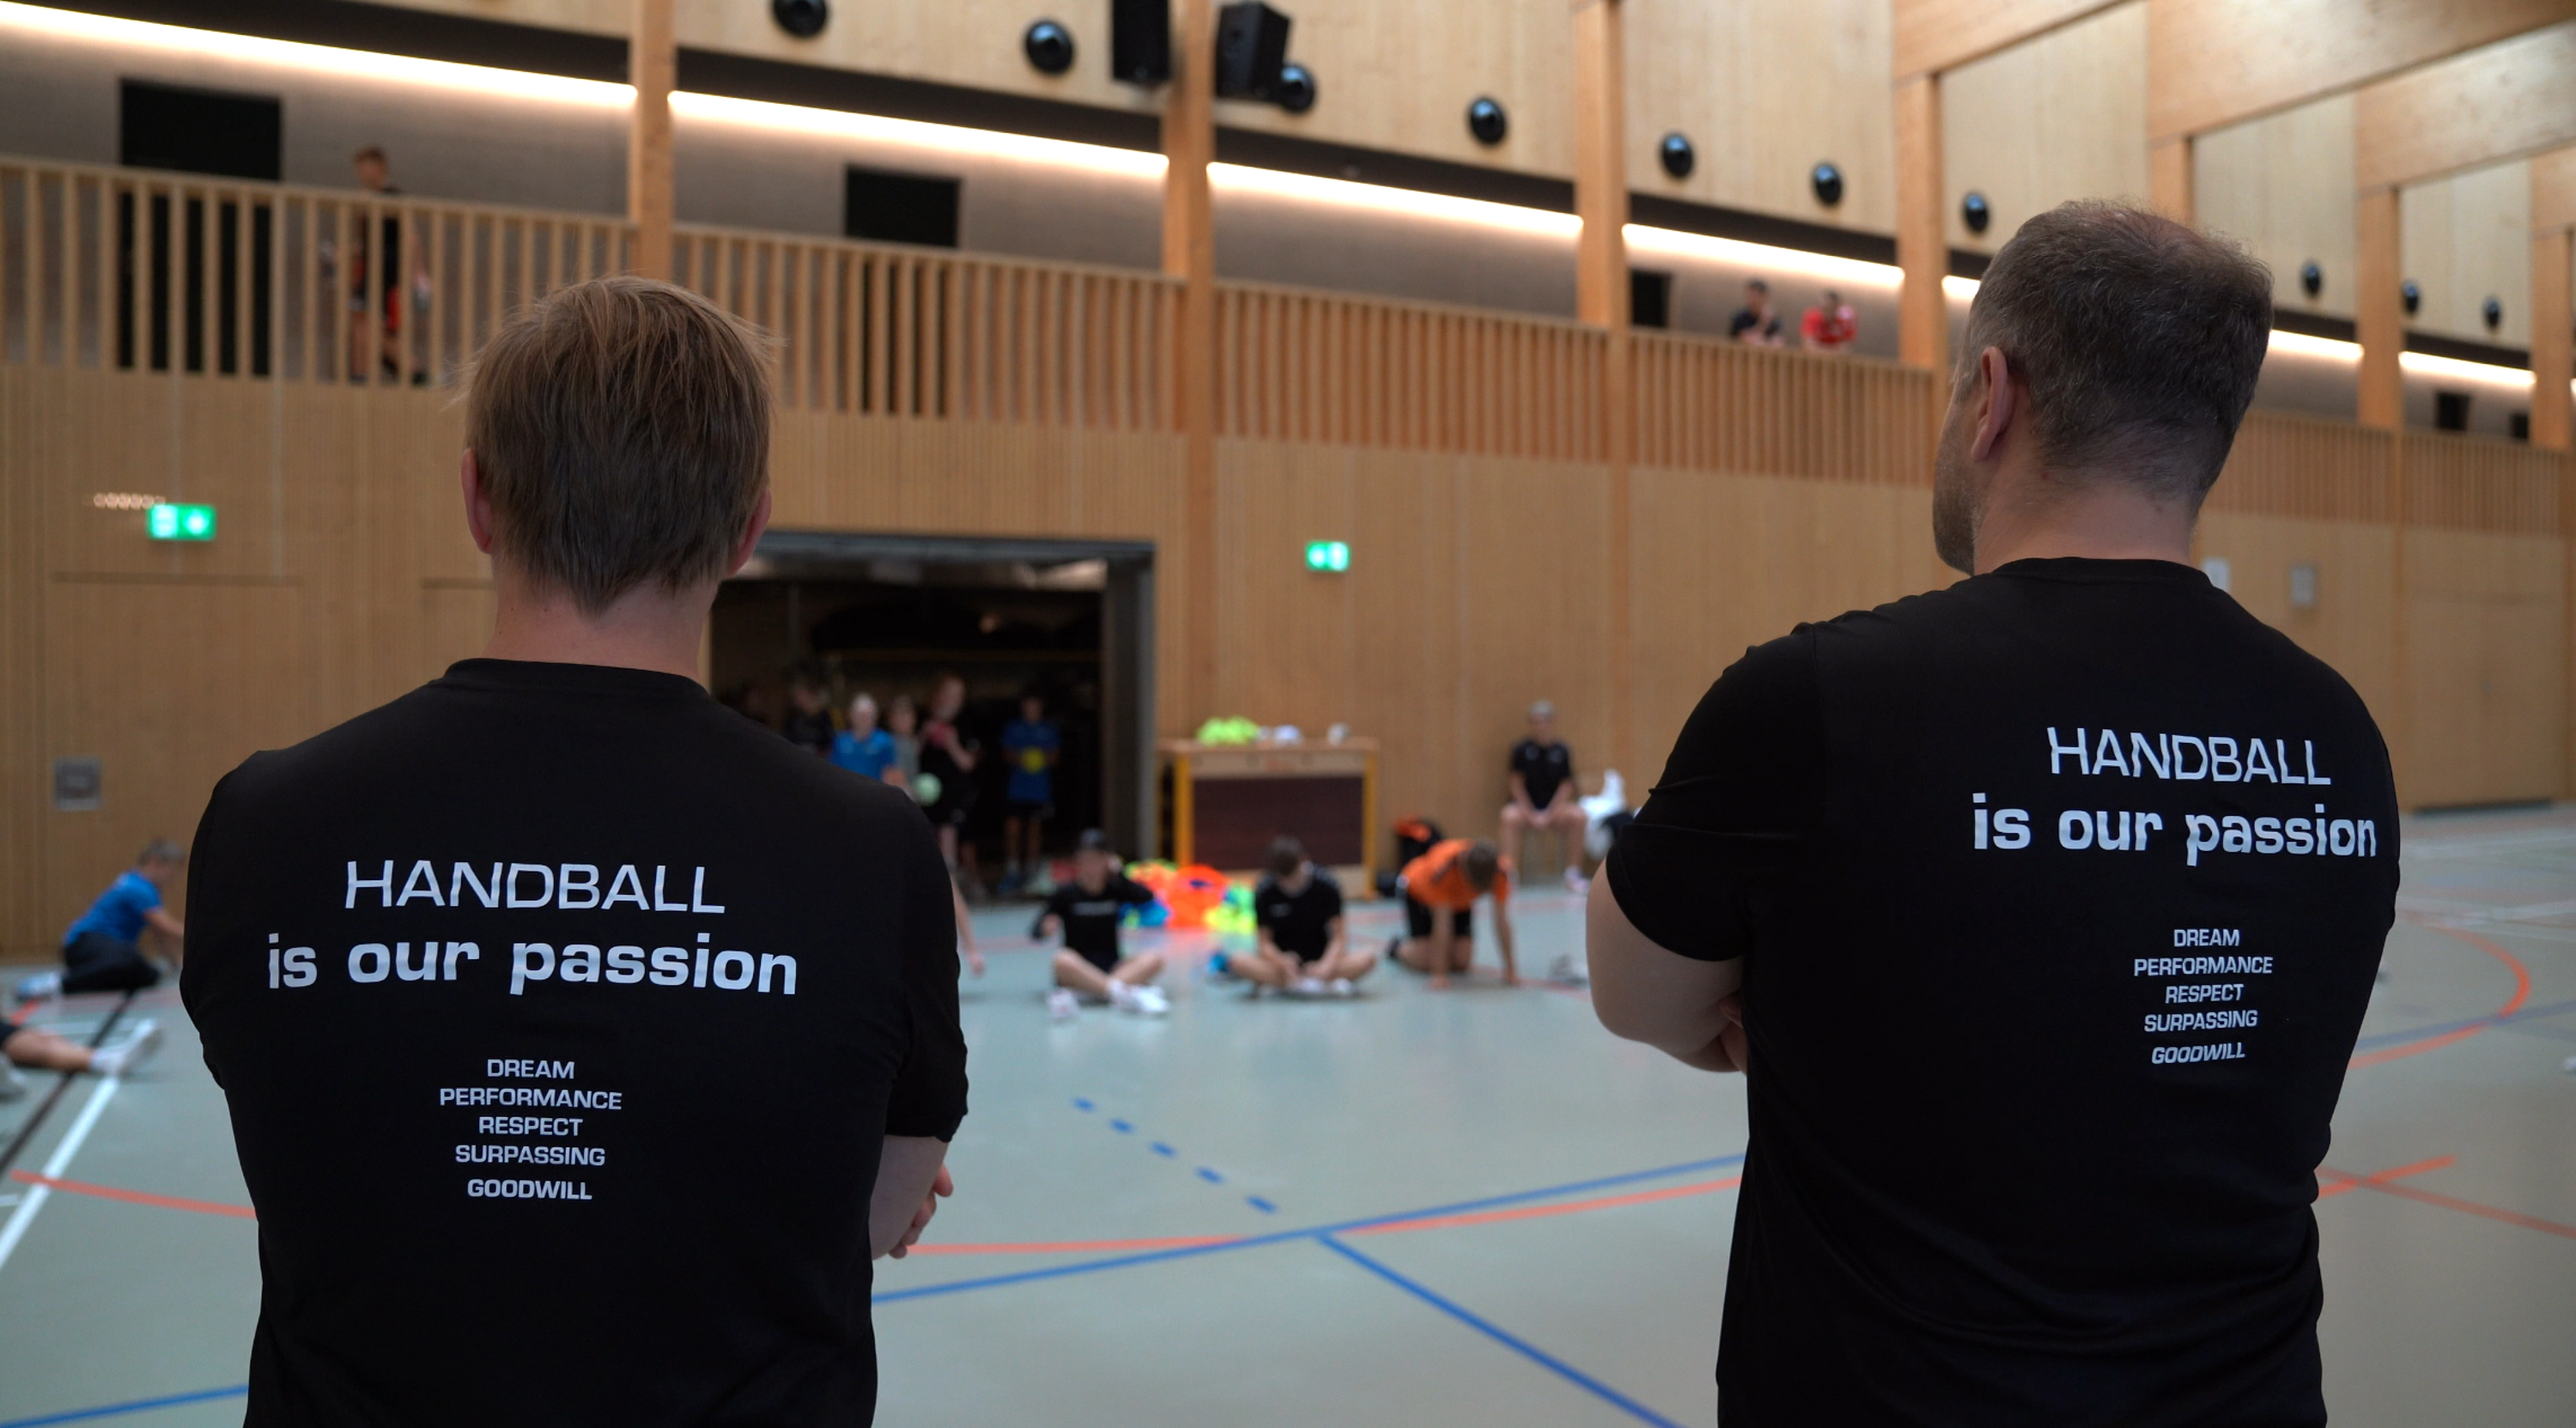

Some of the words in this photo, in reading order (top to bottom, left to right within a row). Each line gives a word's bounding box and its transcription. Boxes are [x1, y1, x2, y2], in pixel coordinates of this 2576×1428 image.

[2046, 726, 2332, 786] HANDBALL
[1972, 792, 2032, 851] is
[2057, 809, 2164, 852] our
[2184, 803, 2378, 867] passion
[345, 860, 726, 915] HANDBALL
[2172, 927, 2240, 948] DREAM
[268, 933, 319, 990] is
[347, 941, 481, 984] our
[509, 933, 798, 996] passion
[2133, 956, 2274, 978] PERFORMANCE
[2164, 983, 2245, 1004] RESPECT
[2143, 1009, 2259, 1033] SURPASSING
[2151, 1042, 2246, 1065] GOODWILL
[487, 1058, 575, 1080] DREAM
[439, 1086, 623, 1111] PERFORMANCE
[477, 1115, 584, 1137] RESPECT
[454, 1144, 605, 1167] SURPASSING
[467, 1178, 592, 1201] GOODWILL
